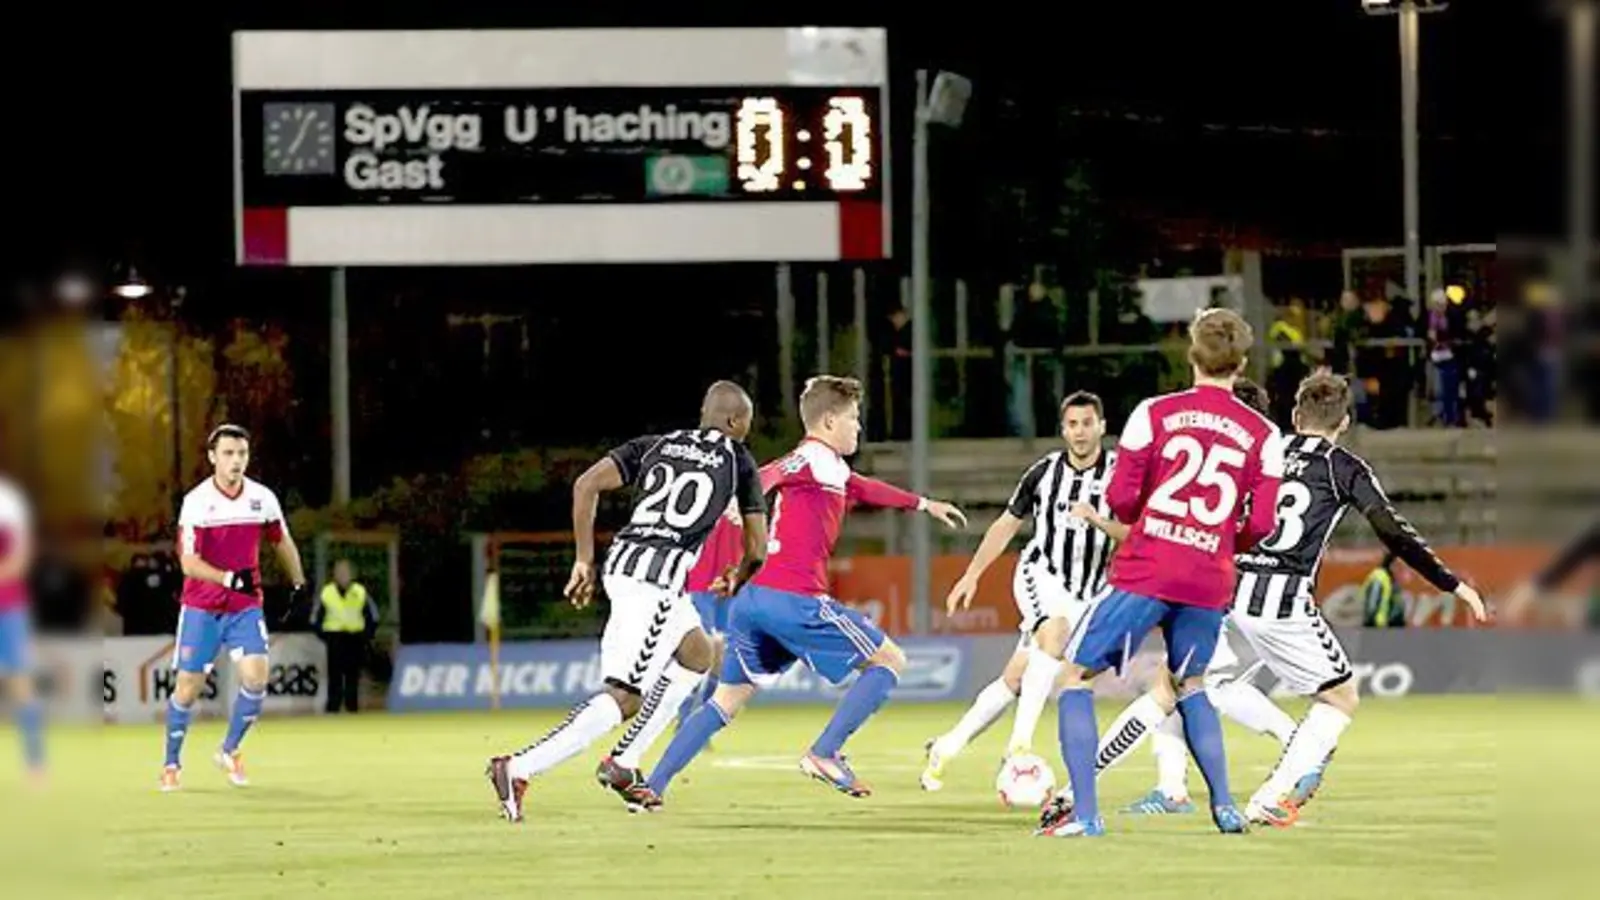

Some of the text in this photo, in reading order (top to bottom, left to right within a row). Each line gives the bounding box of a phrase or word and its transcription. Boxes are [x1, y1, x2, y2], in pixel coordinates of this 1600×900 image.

[344, 103, 481, 152] SpVgg
[344, 151, 445, 190] Gast
[630, 462, 714, 528] 20
[1147, 433, 1246, 526] 25
[1143, 516, 1221, 554] WILLSCH
[400, 662, 469, 697] DER
[474, 660, 558, 696] KICK
